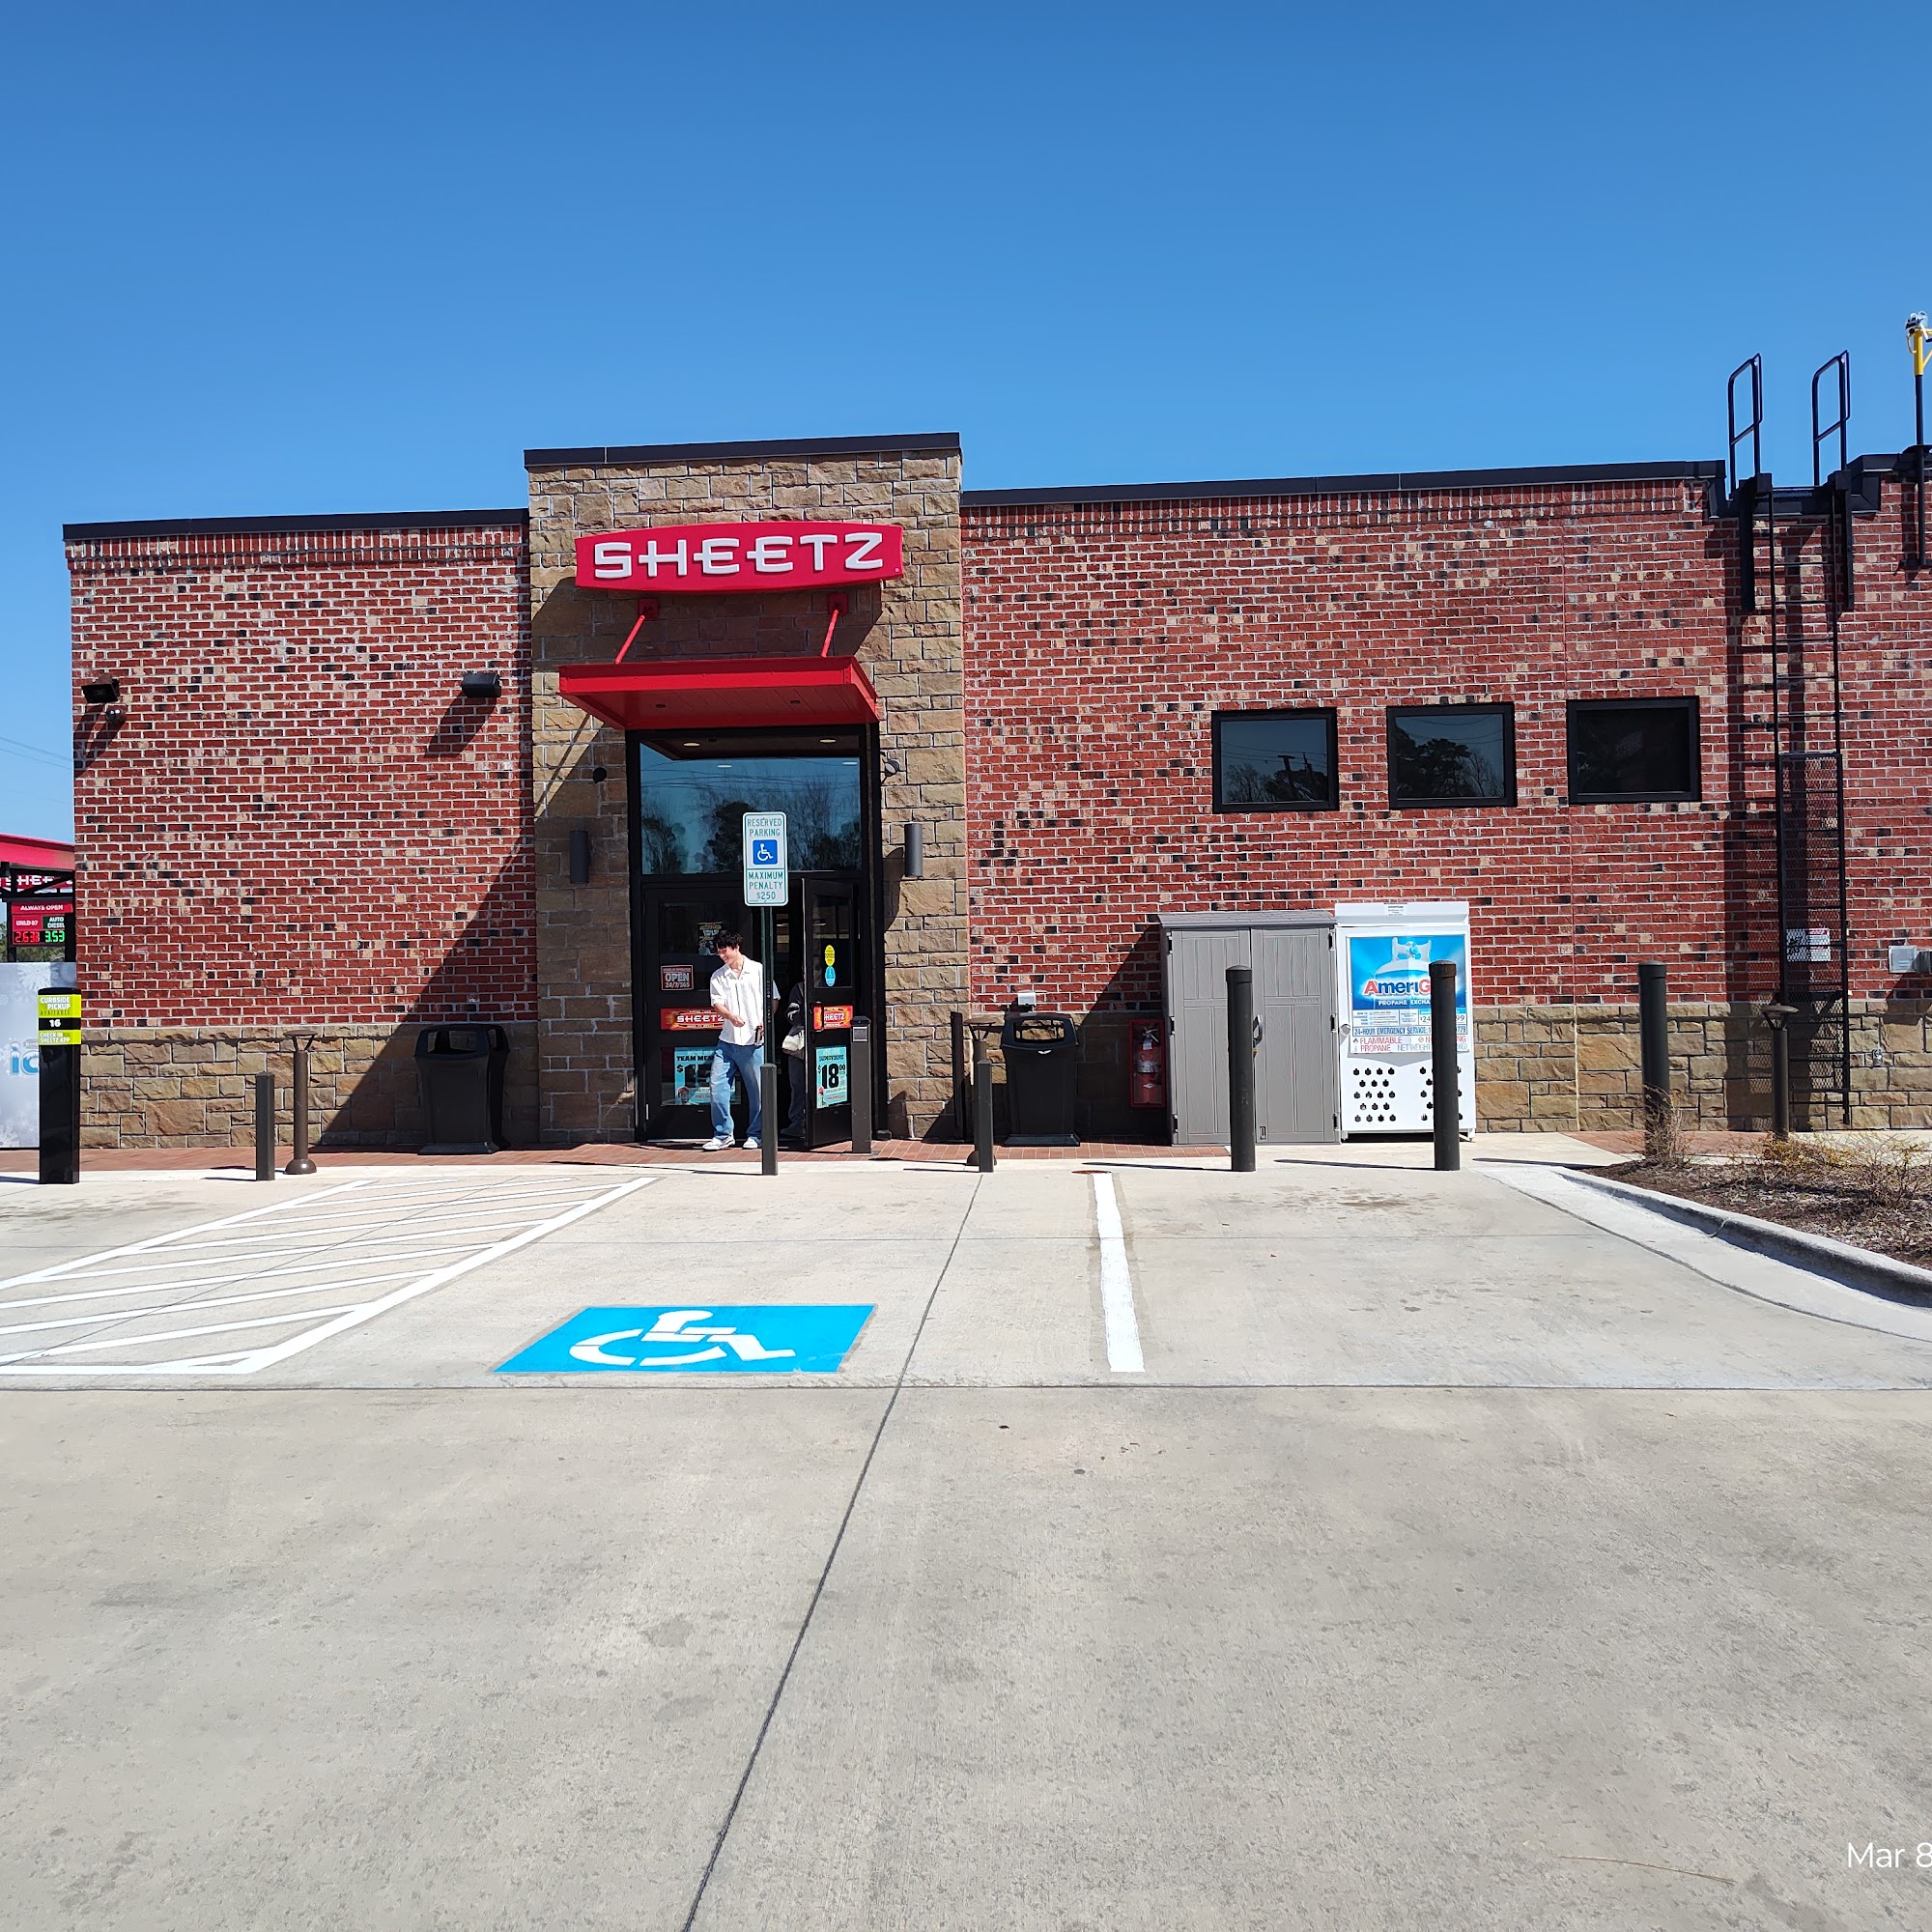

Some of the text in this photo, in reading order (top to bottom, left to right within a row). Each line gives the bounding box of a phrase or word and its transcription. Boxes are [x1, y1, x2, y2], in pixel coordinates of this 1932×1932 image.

[594, 532, 883, 579] SHEETZ
[747, 818, 782, 827] RESERVED
[749, 828, 781, 838] PARKING
[748, 871, 783, 880] MAXIMUM
[749, 881, 783, 890] PENALTY
[756, 891, 776, 899] $250
[44, 930, 66, 943] 3.53
[665, 973, 690, 982] OPEN
[1364, 979, 1432, 995] AmeriG
[676, 1014, 724, 1023] SHEETZ
[823, 1012, 845, 1021] HEETZ
[49, 1019, 61, 1028] 16
